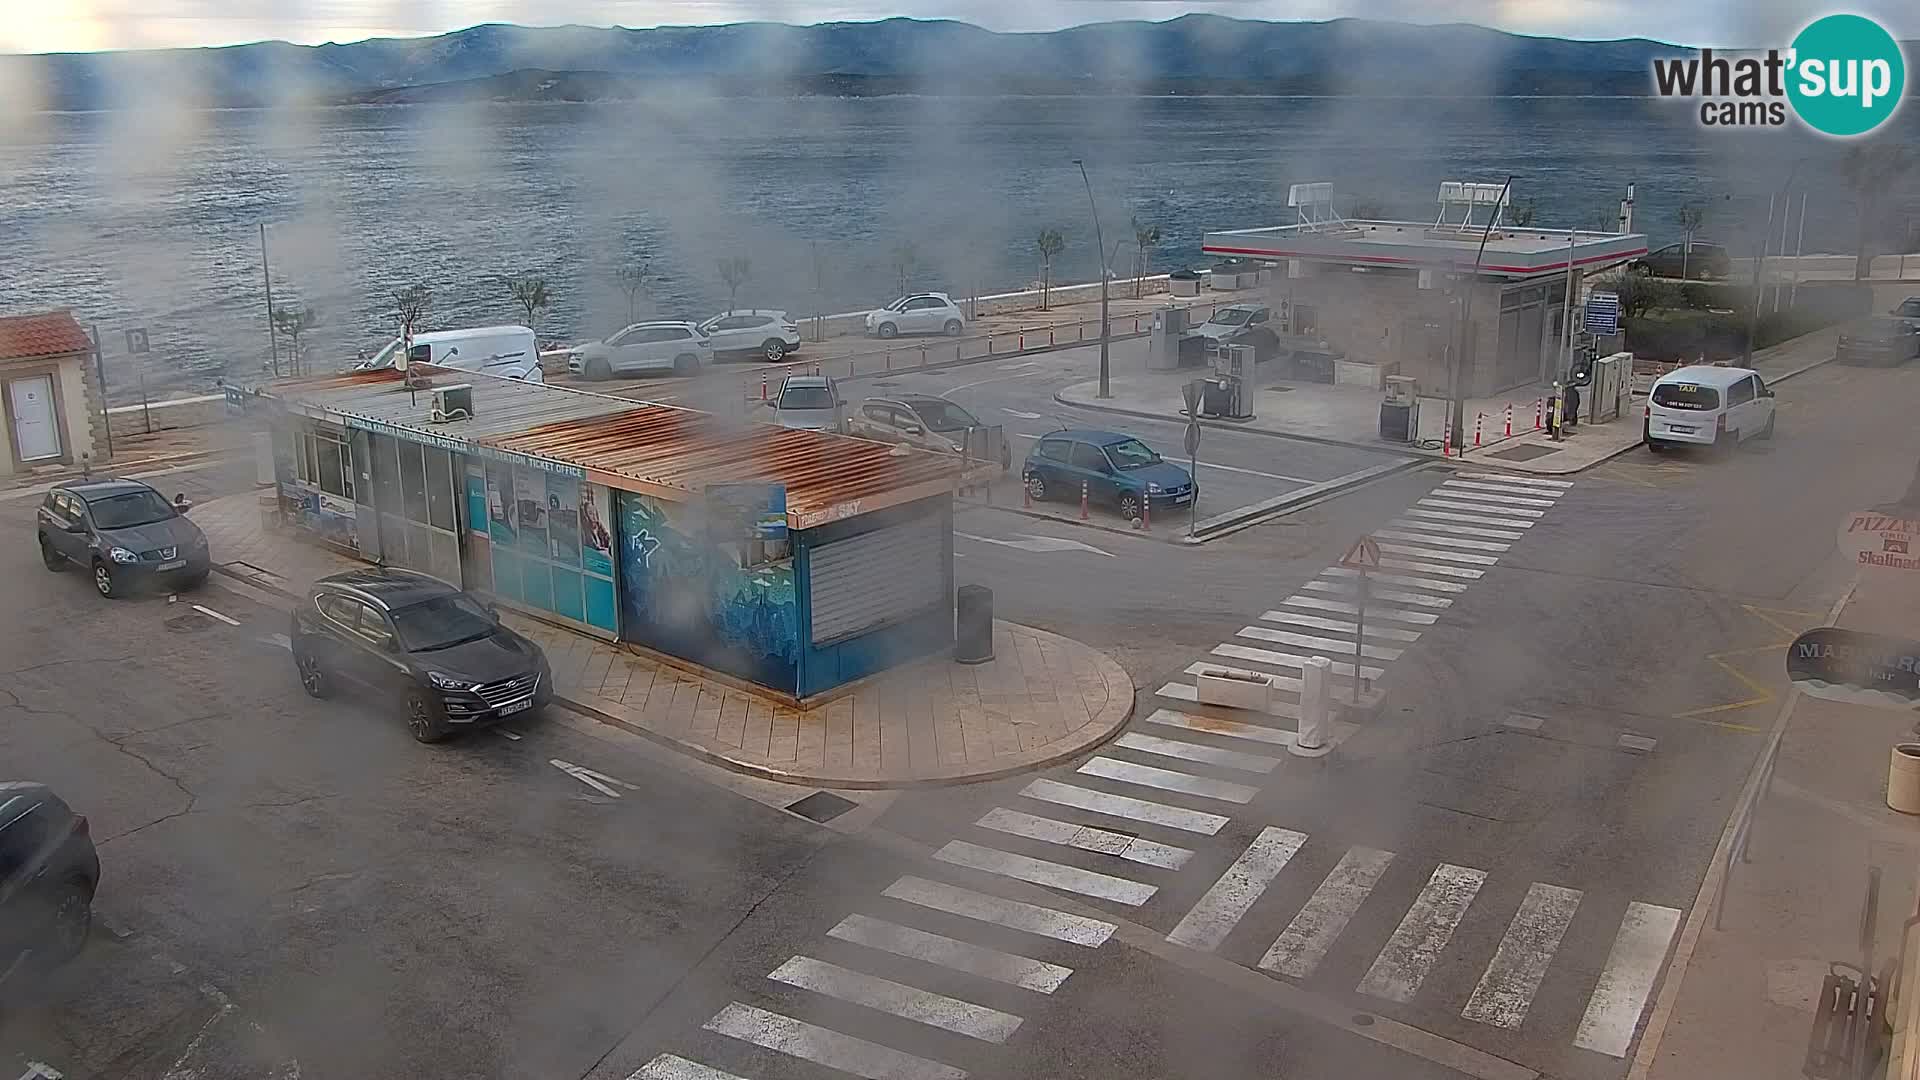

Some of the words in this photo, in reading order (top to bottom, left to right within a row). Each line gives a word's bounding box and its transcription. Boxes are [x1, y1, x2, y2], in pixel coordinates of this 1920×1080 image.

[1678, 385, 1697, 393] TAXI
[437, 438, 467, 453] POSTAJA
[529, 458, 553, 472] TICKET
[555, 464, 582, 478] OFFICE
